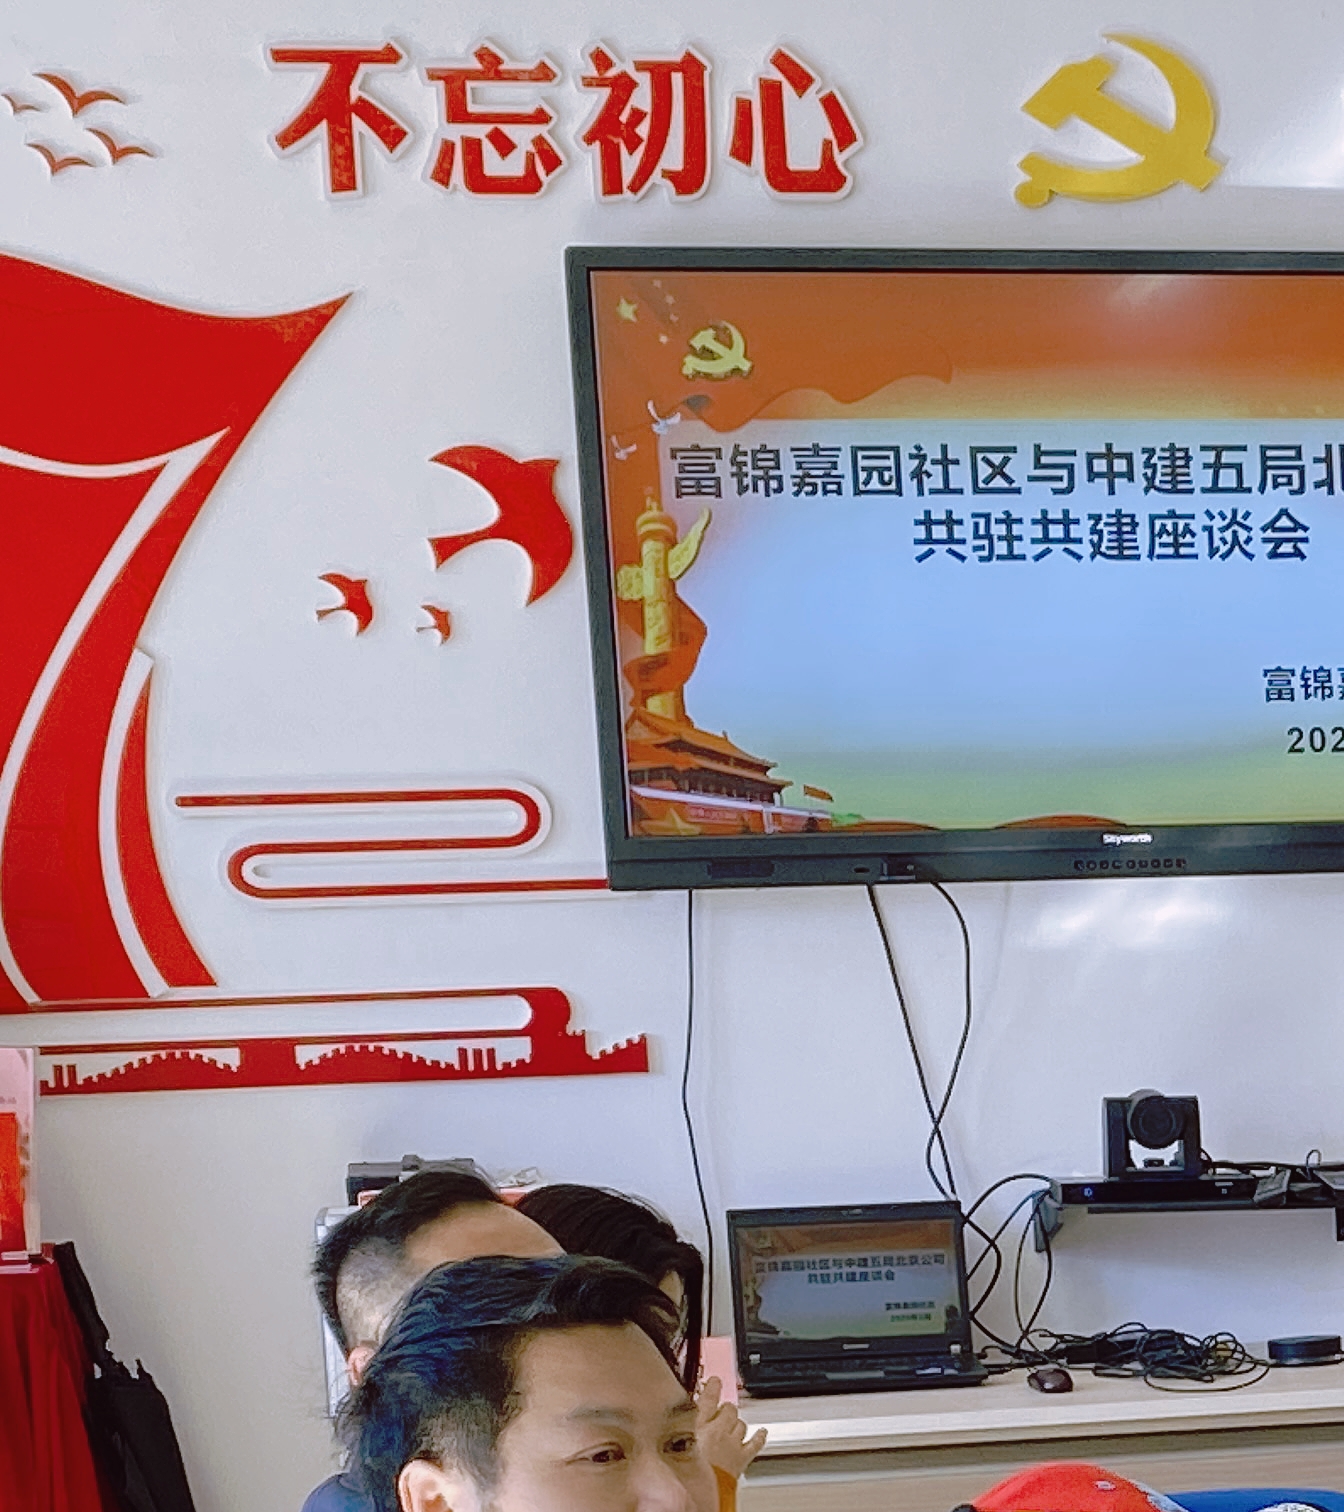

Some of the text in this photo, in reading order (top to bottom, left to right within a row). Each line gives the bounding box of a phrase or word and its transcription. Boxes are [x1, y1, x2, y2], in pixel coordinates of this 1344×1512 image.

[270, 42, 860, 198] 不忘初心
[911, 506, 1311, 565] 共驻共建座谈会
